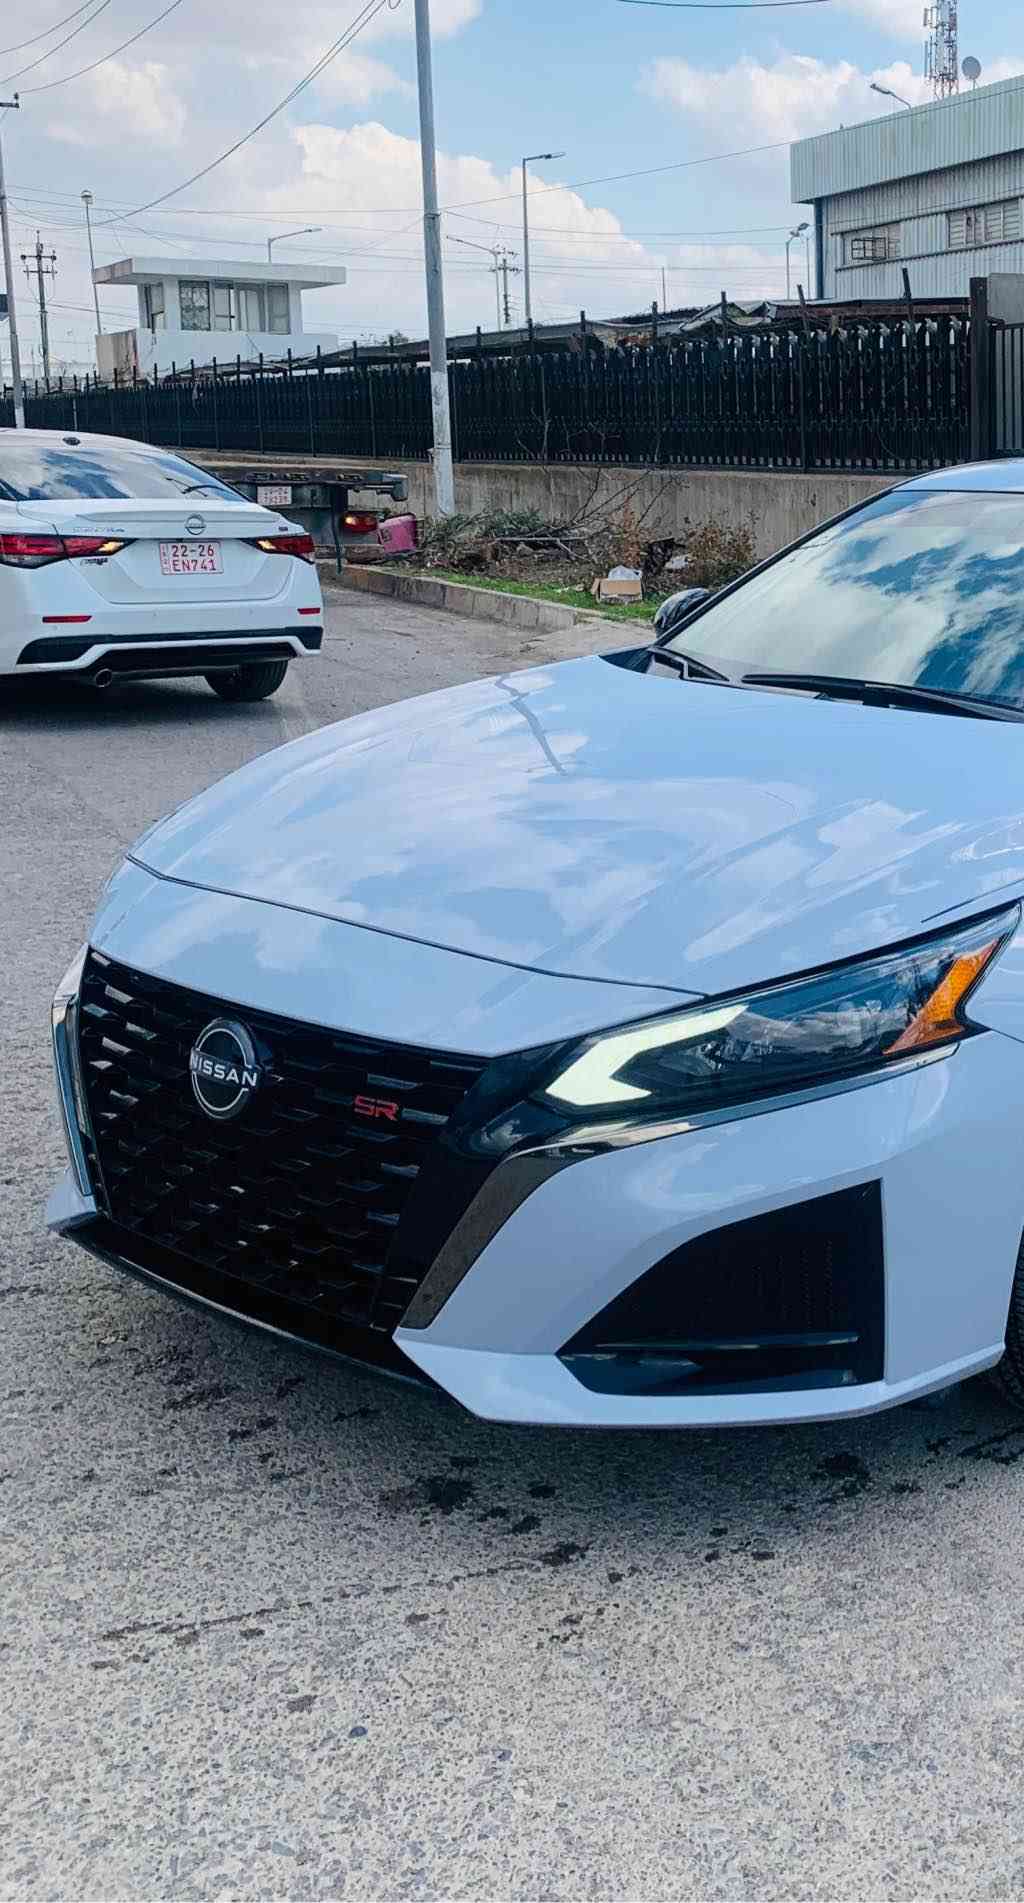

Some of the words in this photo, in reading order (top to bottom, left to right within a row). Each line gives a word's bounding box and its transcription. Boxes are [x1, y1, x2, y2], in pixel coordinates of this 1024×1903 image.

[171, 544, 215, 558] 22-26
[172, 559, 217, 572] EN741
[190, 1050, 258, 1087] NISSAN
[354, 1095, 399, 1121] SR
